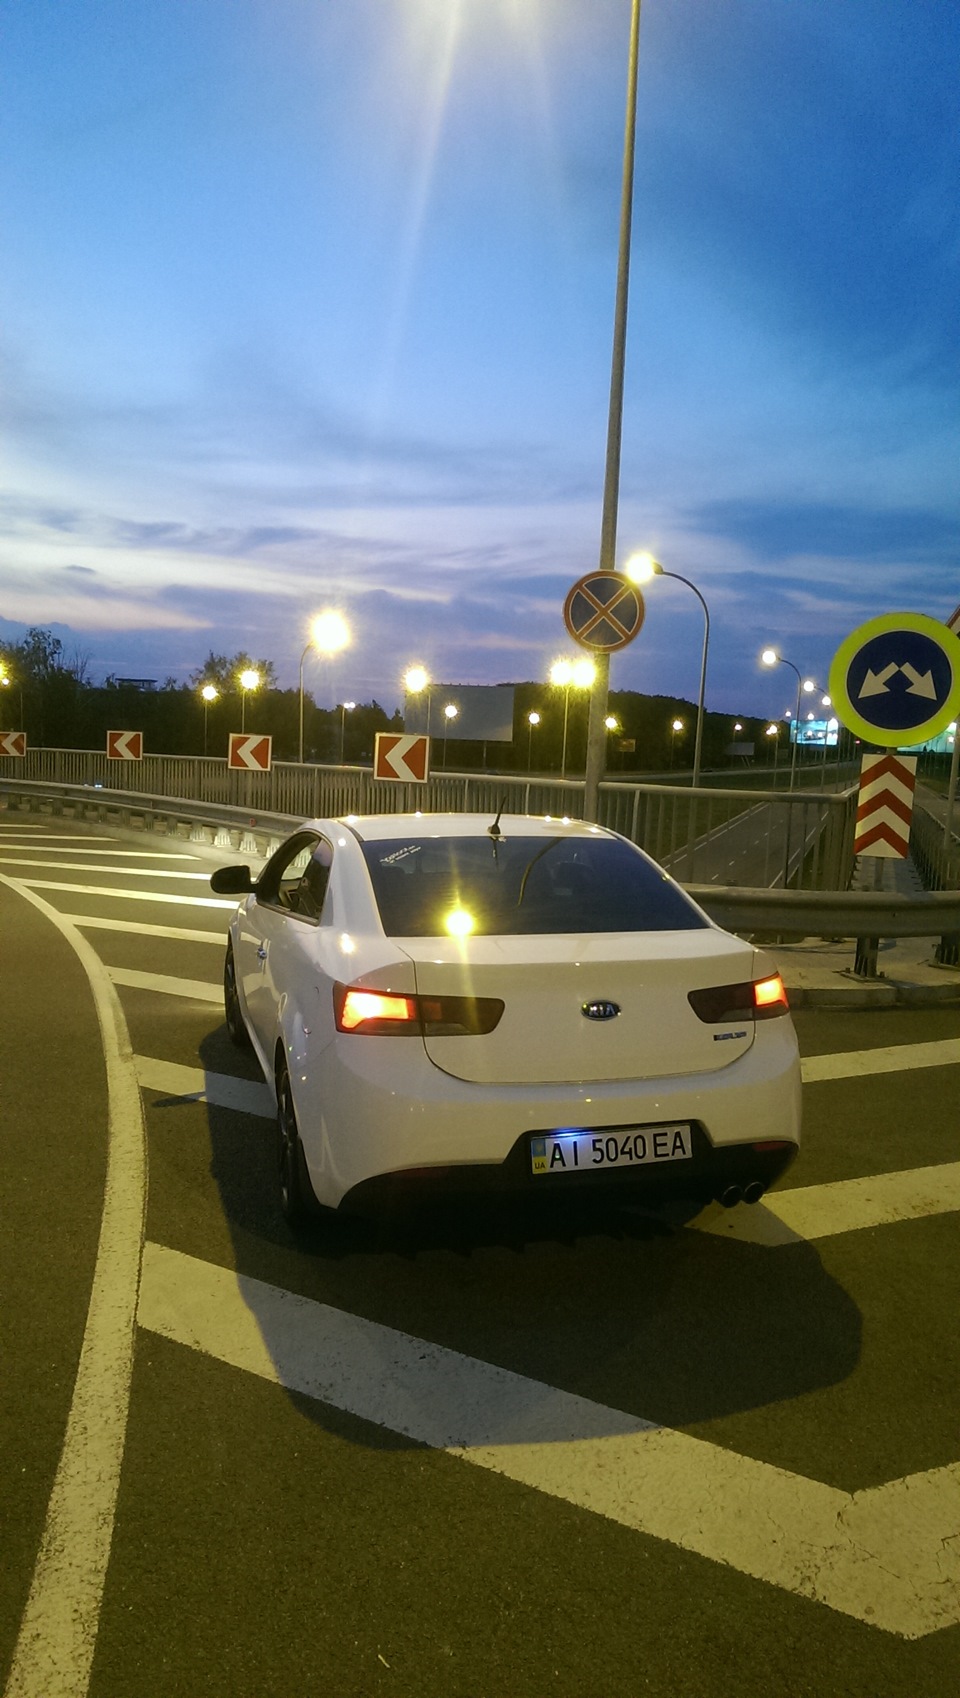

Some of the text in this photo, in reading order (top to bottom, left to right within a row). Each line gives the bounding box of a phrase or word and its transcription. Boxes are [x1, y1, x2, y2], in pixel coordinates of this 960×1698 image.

[588, 1003, 616, 1017] KIA
[550, 1131, 687, 1169] AI 5040 EA
[534, 1161, 546, 1170] UA
